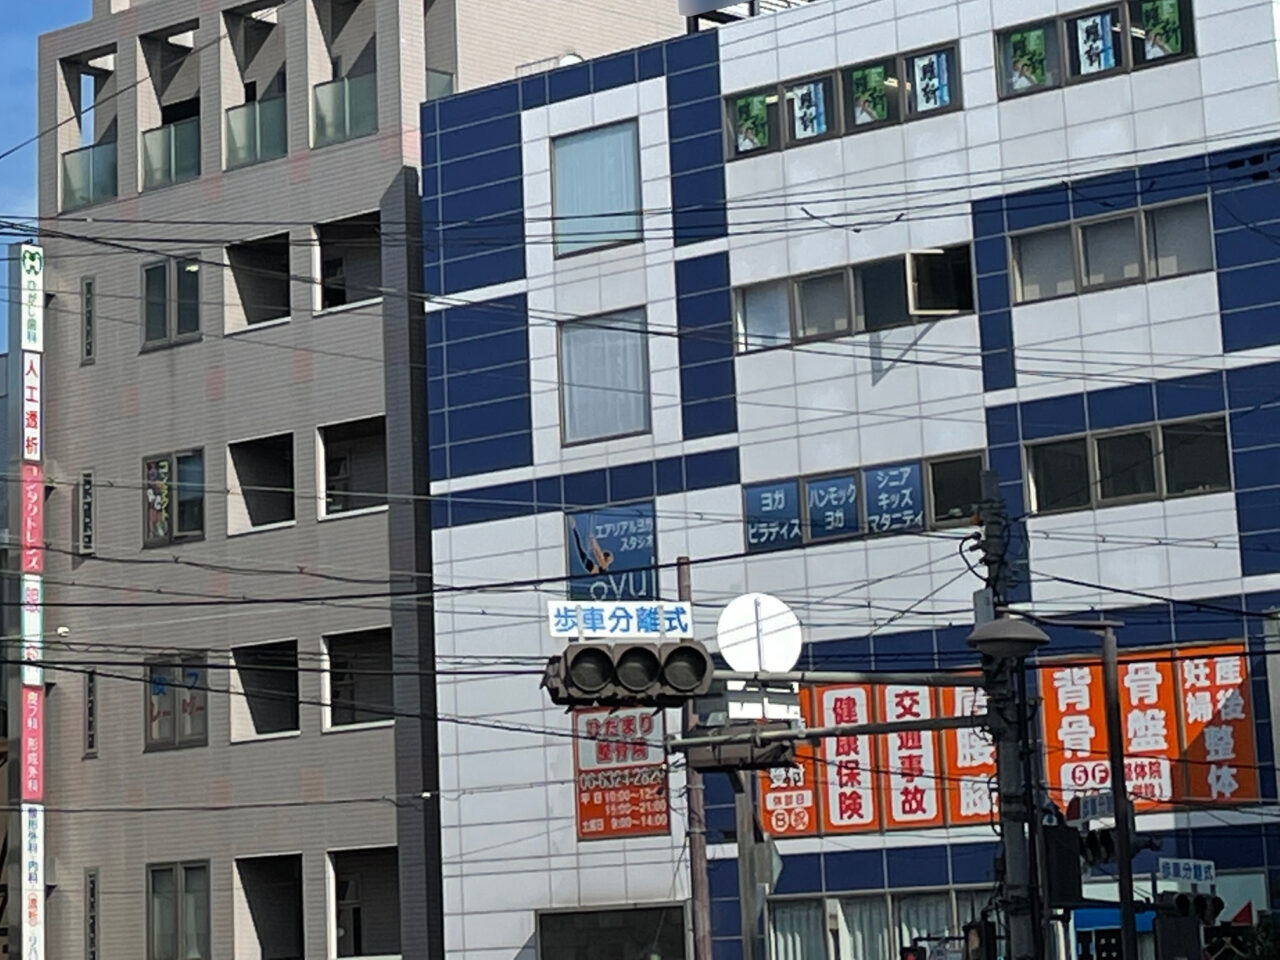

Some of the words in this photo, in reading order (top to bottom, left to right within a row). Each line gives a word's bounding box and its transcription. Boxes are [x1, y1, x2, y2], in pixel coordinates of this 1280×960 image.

[877, 466, 912, 489] シニア
[761, 490, 785, 512] ヨガ
[808, 483, 857, 508] ハンモック
[878, 487, 913, 510] キッズ
[825, 509, 844, 530] ヨガ
[869, 510, 924, 532] マタニティ
[554, 605, 688, 633] 歩車分離式
[1053, 664, 1095, 759] 背骨
[1123, 661, 1168, 752] 骨盤
[833, 696, 864, 820] 健康保険
[894, 690, 927, 815] 交通事故
